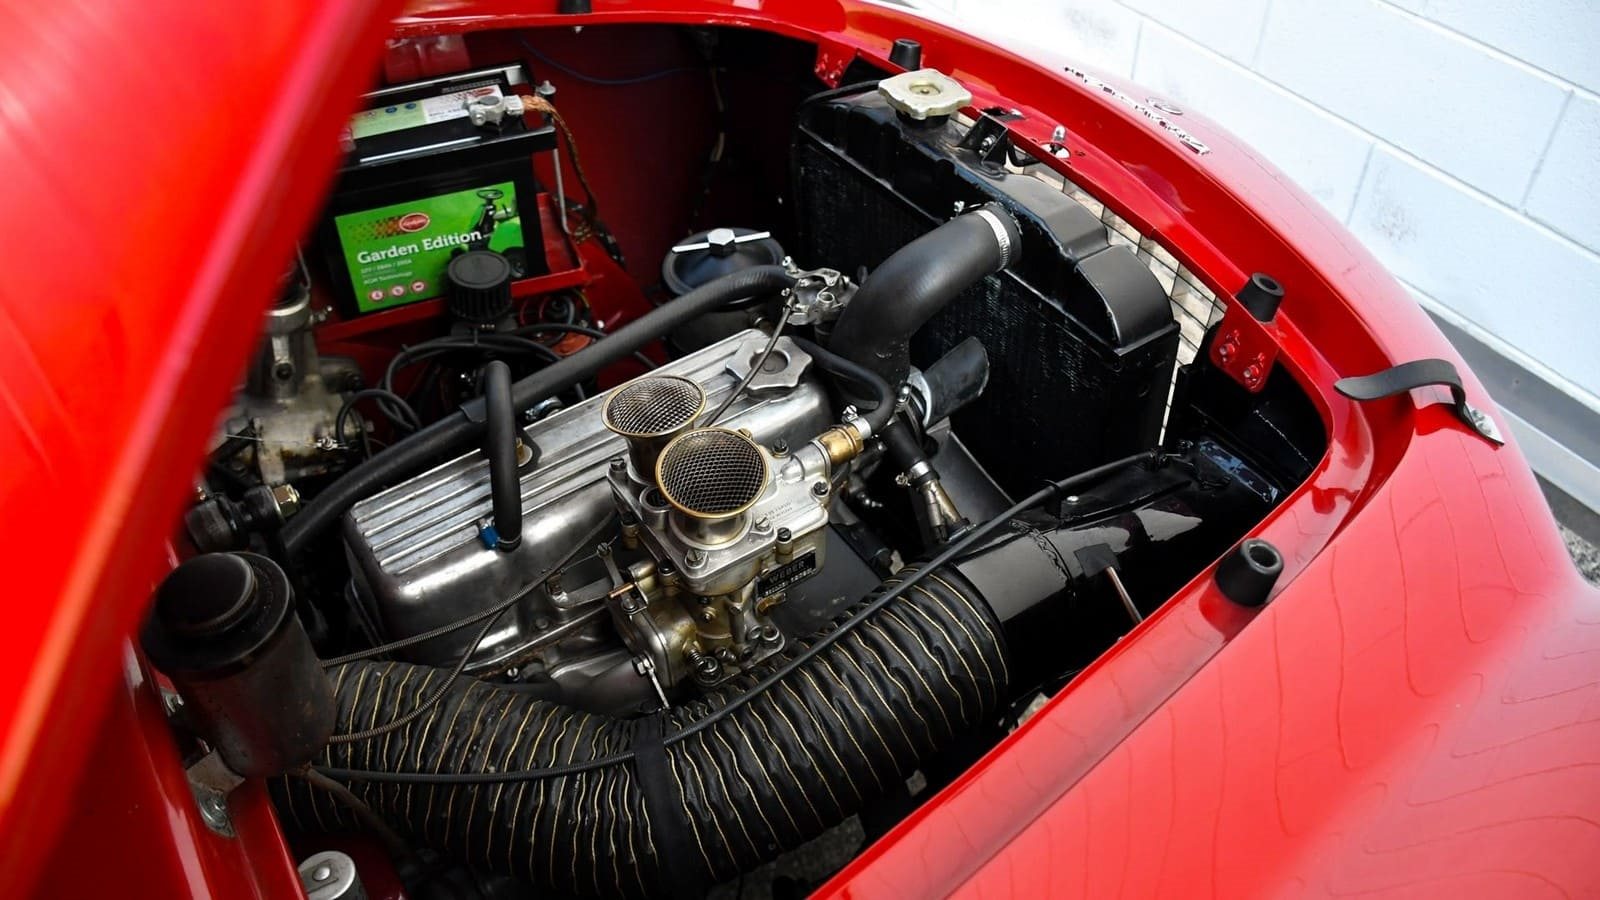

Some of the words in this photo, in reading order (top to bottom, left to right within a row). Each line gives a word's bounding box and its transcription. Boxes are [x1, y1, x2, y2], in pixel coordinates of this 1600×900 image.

[358, 244, 419, 264] Garden
[422, 230, 483, 251] Edition
[769, 561, 805, 583] WEBER
